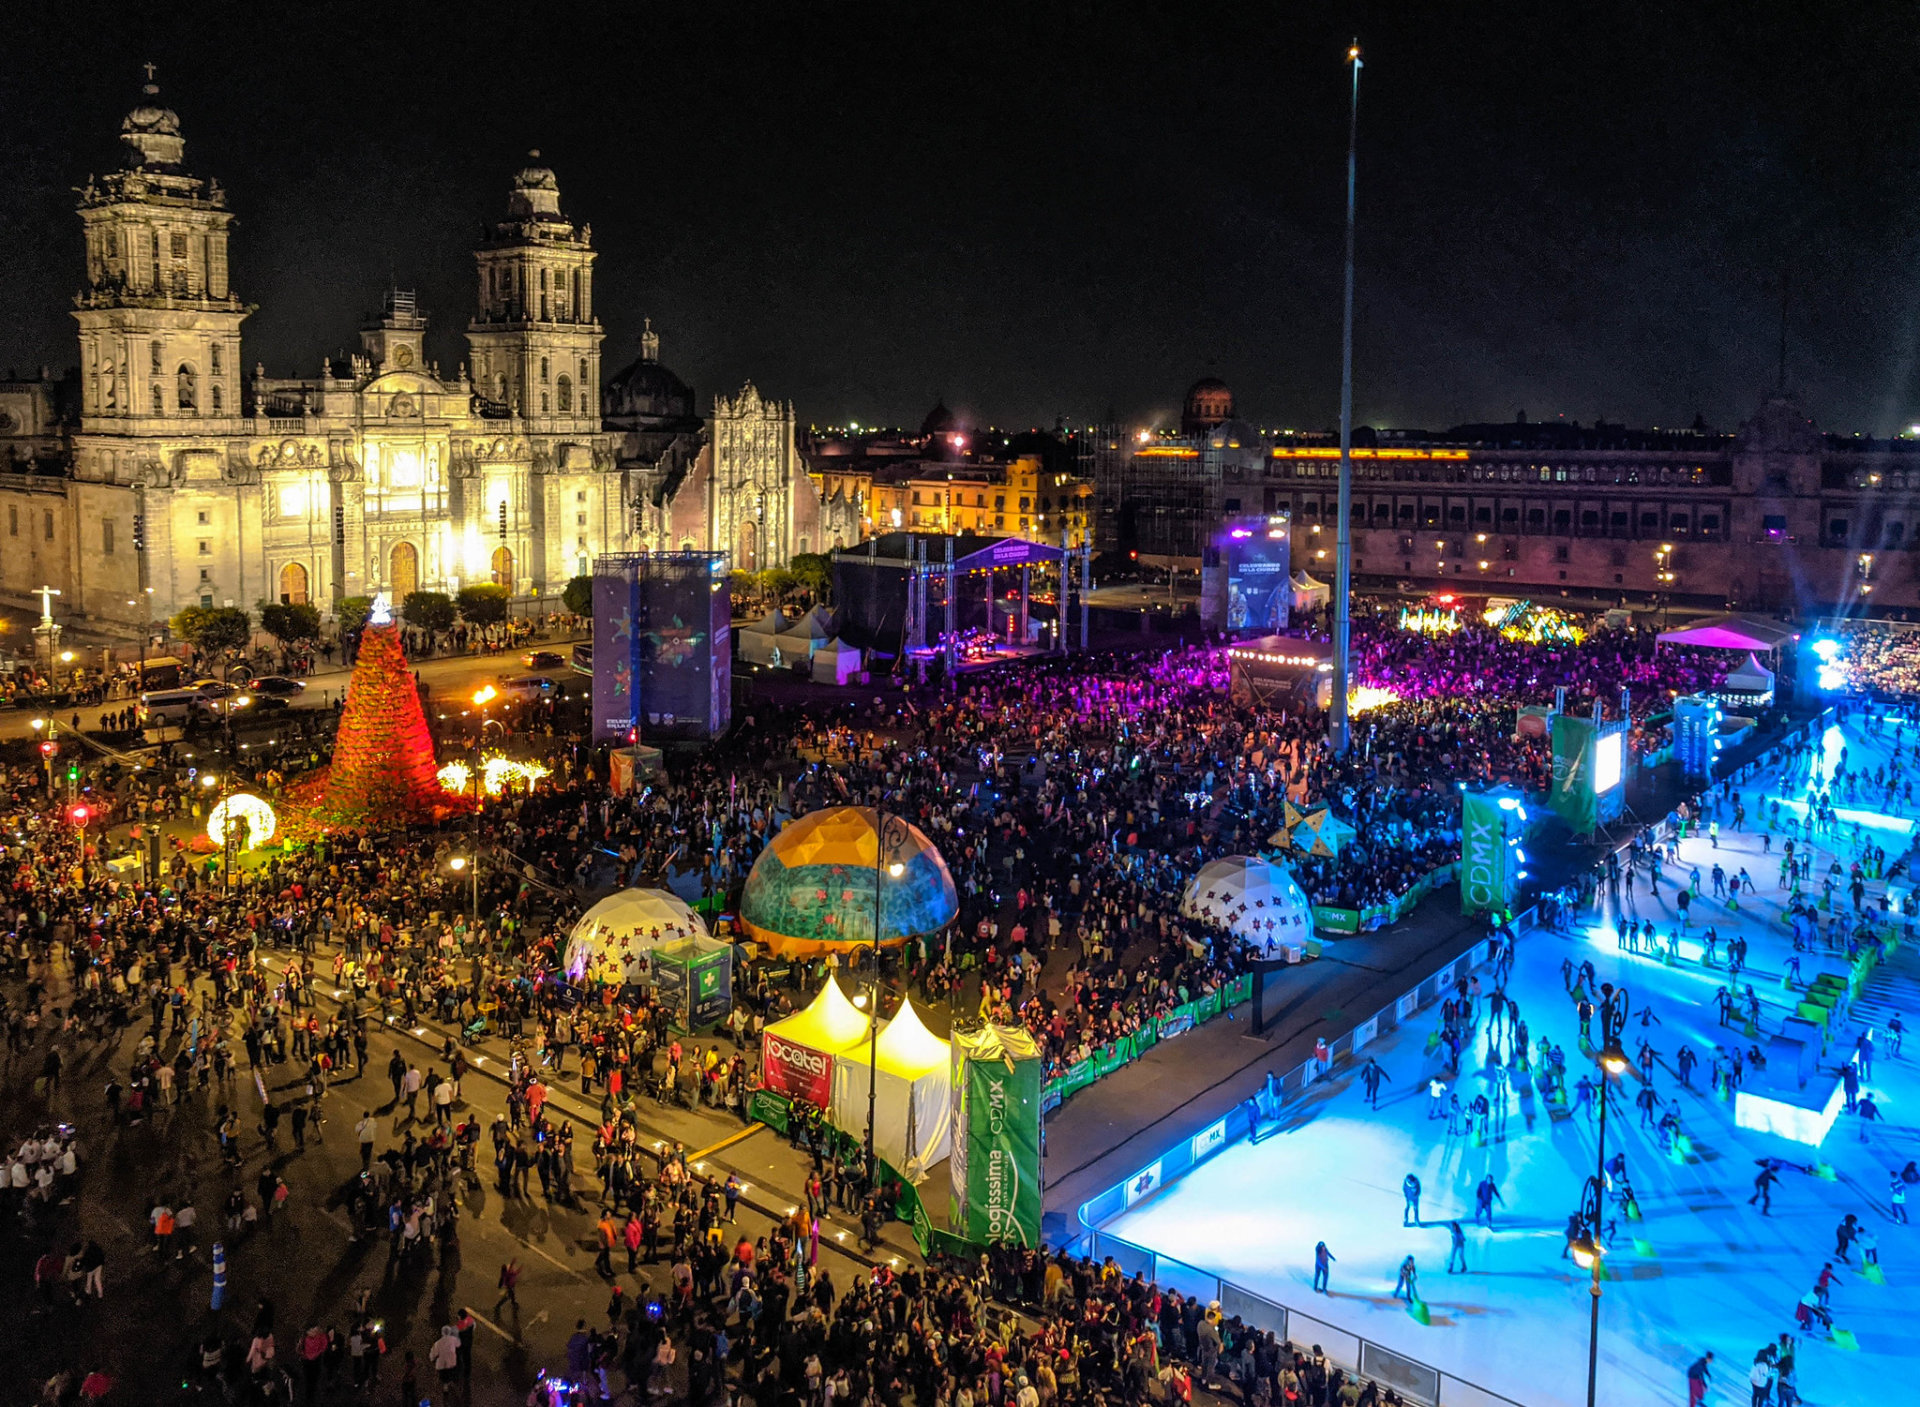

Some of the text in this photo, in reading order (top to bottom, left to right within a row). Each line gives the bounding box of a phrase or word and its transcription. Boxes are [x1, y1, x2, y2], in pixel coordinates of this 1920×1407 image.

[1470, 820, 1492, 905] CDMX
[1319, 910, 1346, 921] CDMX
[990, 1079, 1004, 1135] CDMX
